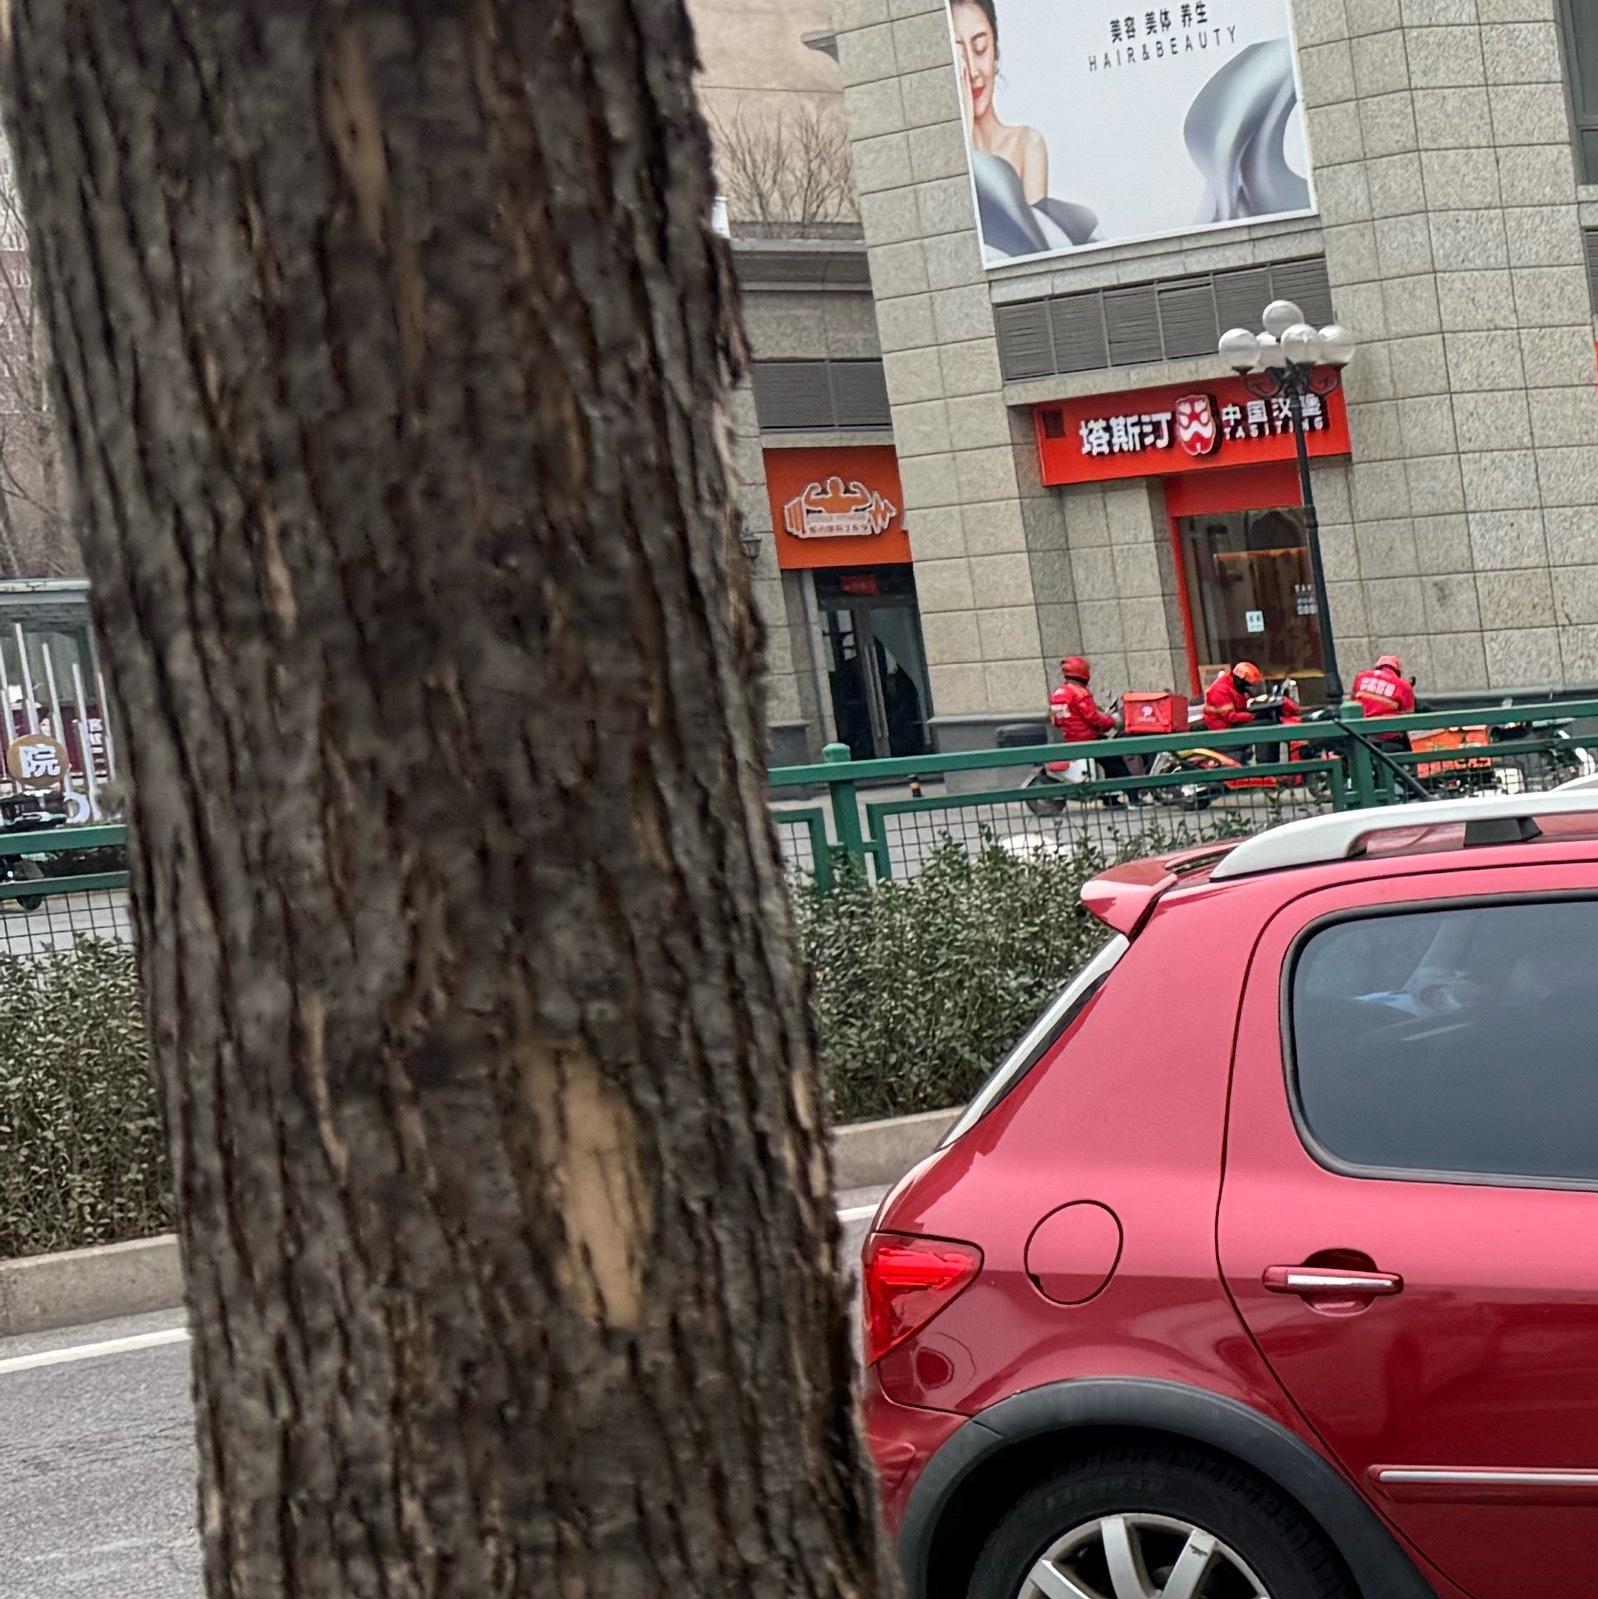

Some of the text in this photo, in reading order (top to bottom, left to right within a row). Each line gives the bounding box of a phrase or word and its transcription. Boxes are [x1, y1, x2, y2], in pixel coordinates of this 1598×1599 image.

[1110, 2, 1208, 43] 美容 美体 养生
[1088, 25, 1236, 72] HAIR&BEAUTY
[1222, 393, 1323, 426] 中国汉堡
[1079, 410, 1173, 456] 塔斯汀
[19, 744, 60, 778] 院
